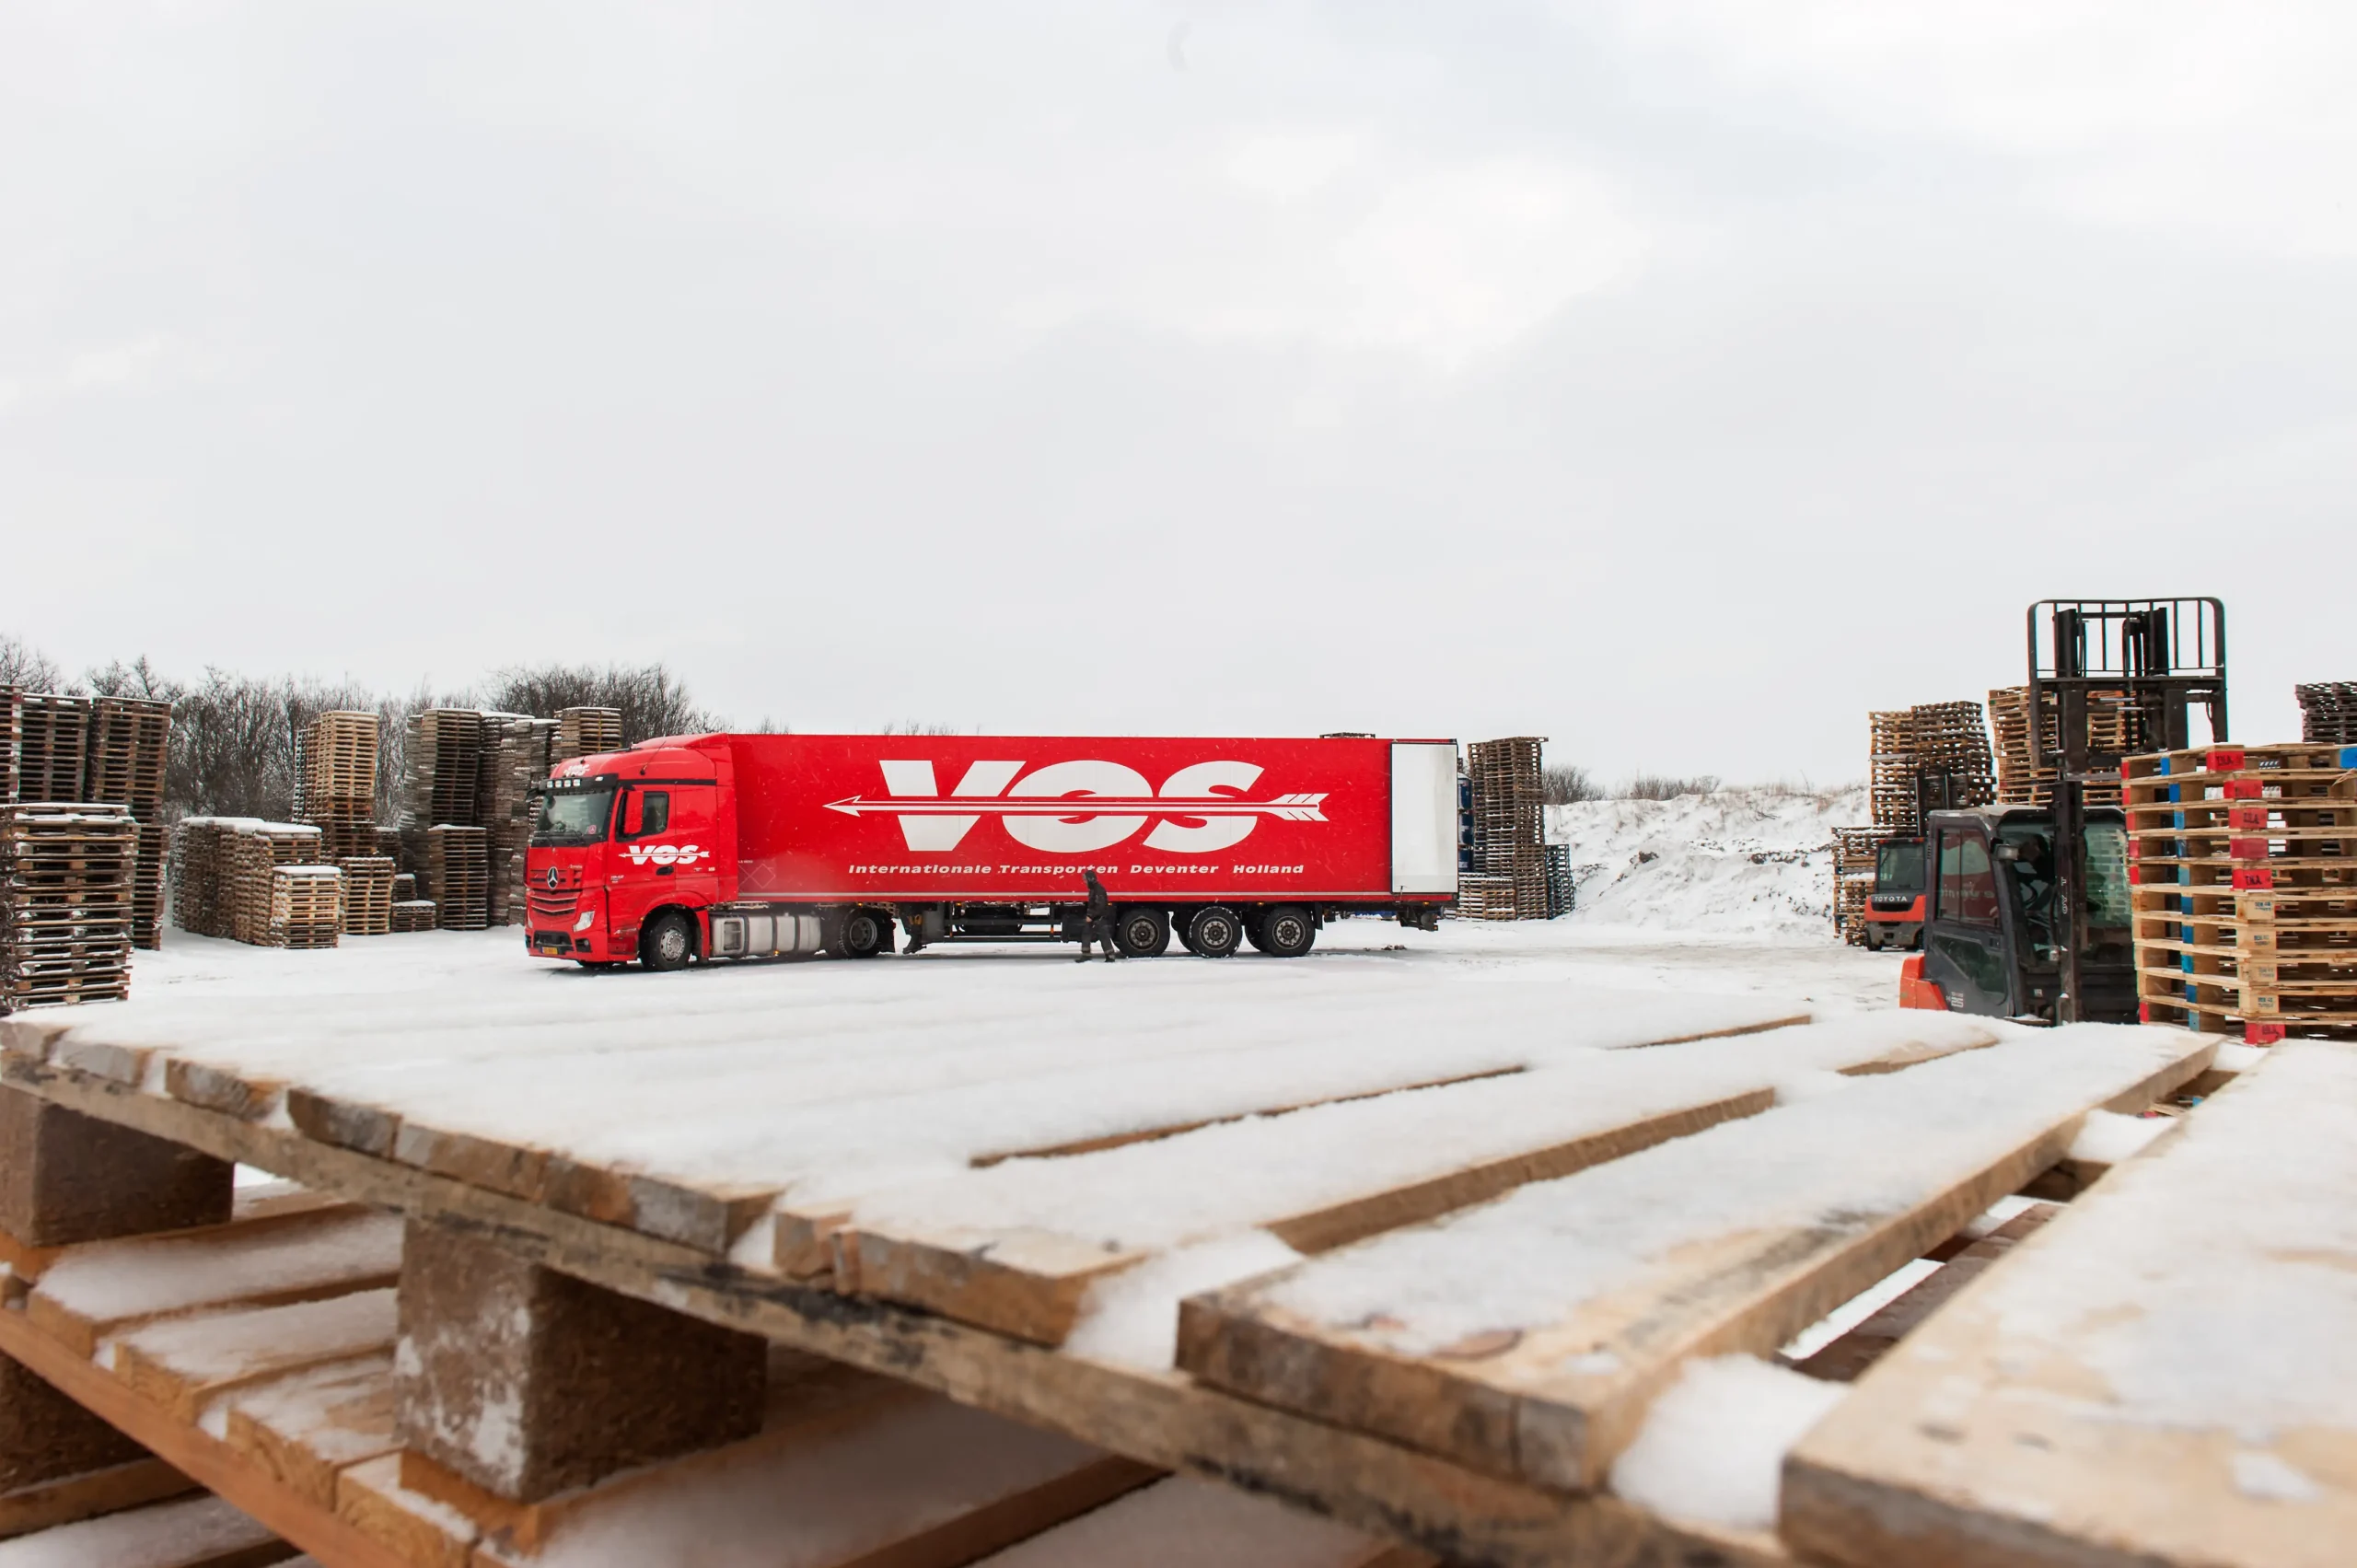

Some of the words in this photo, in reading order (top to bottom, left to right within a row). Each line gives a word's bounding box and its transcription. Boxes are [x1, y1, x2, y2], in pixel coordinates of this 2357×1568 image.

[878, 760, 1265, 854] VOS
[628, 844, 699, 865] VOS
[849, 864, 992, 875] Internationale
[1130, 864, 1219, 874] Deventer
[1233, 864, 1305, 874] Holland
